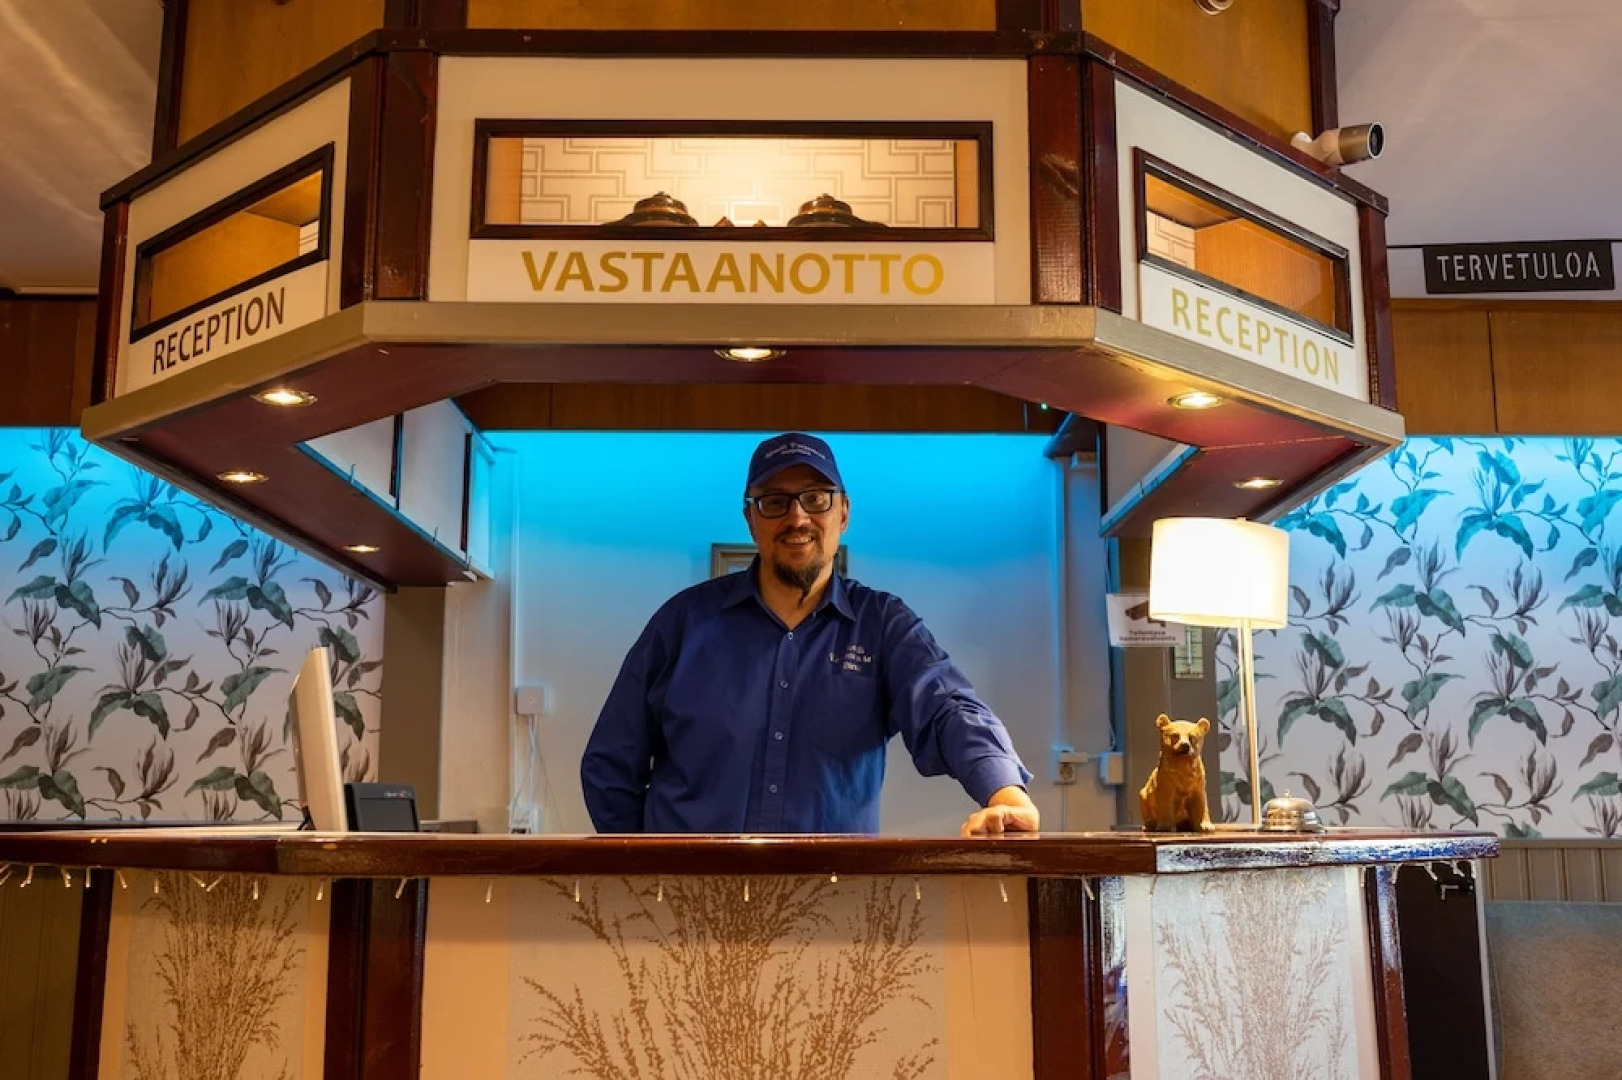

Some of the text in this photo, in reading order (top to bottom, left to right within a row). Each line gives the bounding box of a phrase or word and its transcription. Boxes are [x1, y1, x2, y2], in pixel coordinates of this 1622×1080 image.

[521, 251, 945, 296] VASTAANOTTO
[1436, 251, 1601, 282] TERVETULOA
[153, 286, 285, 375] RECEPTION
[1171, 287, 1339, 385] RECEPTION
